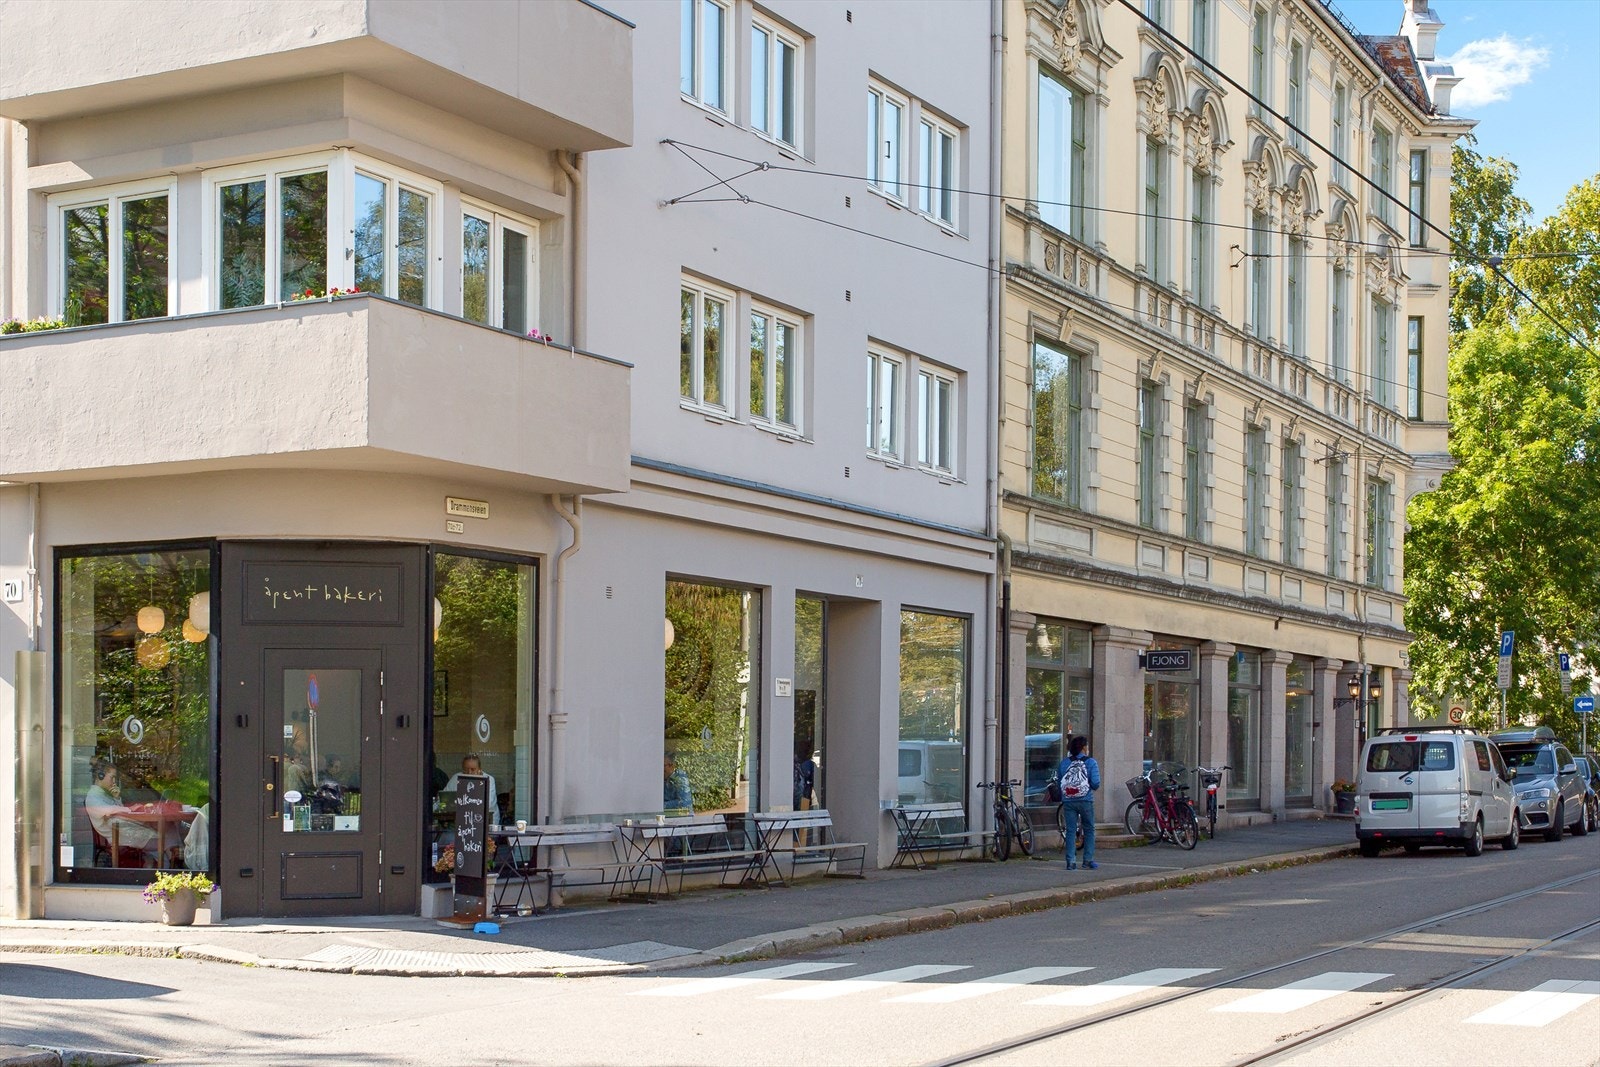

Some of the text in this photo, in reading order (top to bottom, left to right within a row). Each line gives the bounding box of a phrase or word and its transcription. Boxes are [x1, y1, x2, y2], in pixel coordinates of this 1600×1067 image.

[450, 500, 487, 515] Drammensveien
[5, 582, 17, 598] 70
[264, 577, 383, 609] åpent bakeri
[1502, 634, 1511, 654] P
[1152, 655, 1185, 666] FJONG
[1561, 655, 1568, 670] P
[1452, 710, 1463, 720] 30
